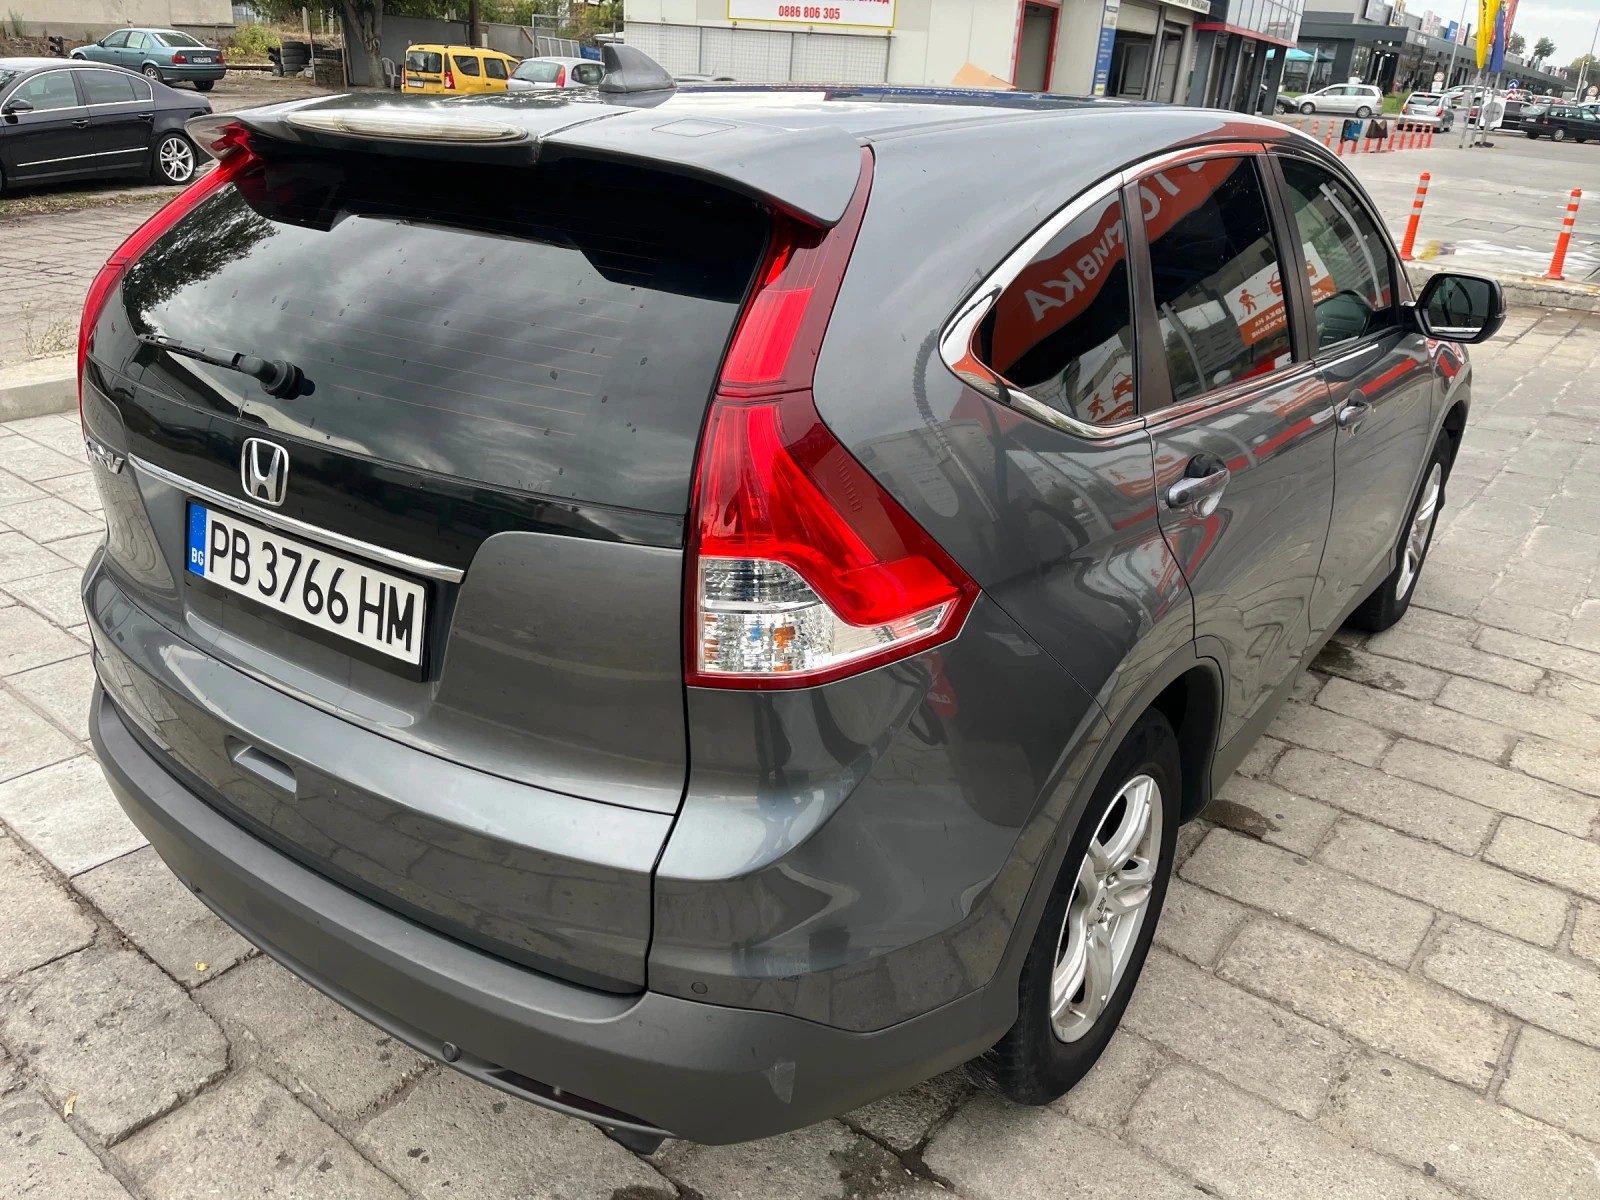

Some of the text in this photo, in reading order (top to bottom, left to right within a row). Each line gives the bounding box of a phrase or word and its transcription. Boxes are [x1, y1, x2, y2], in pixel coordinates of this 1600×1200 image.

[778, 5, 841, 20] 0886 806 305
[191, 547, 205, 566] BG
[209, 520, 415, 651] PB 3766 HM
